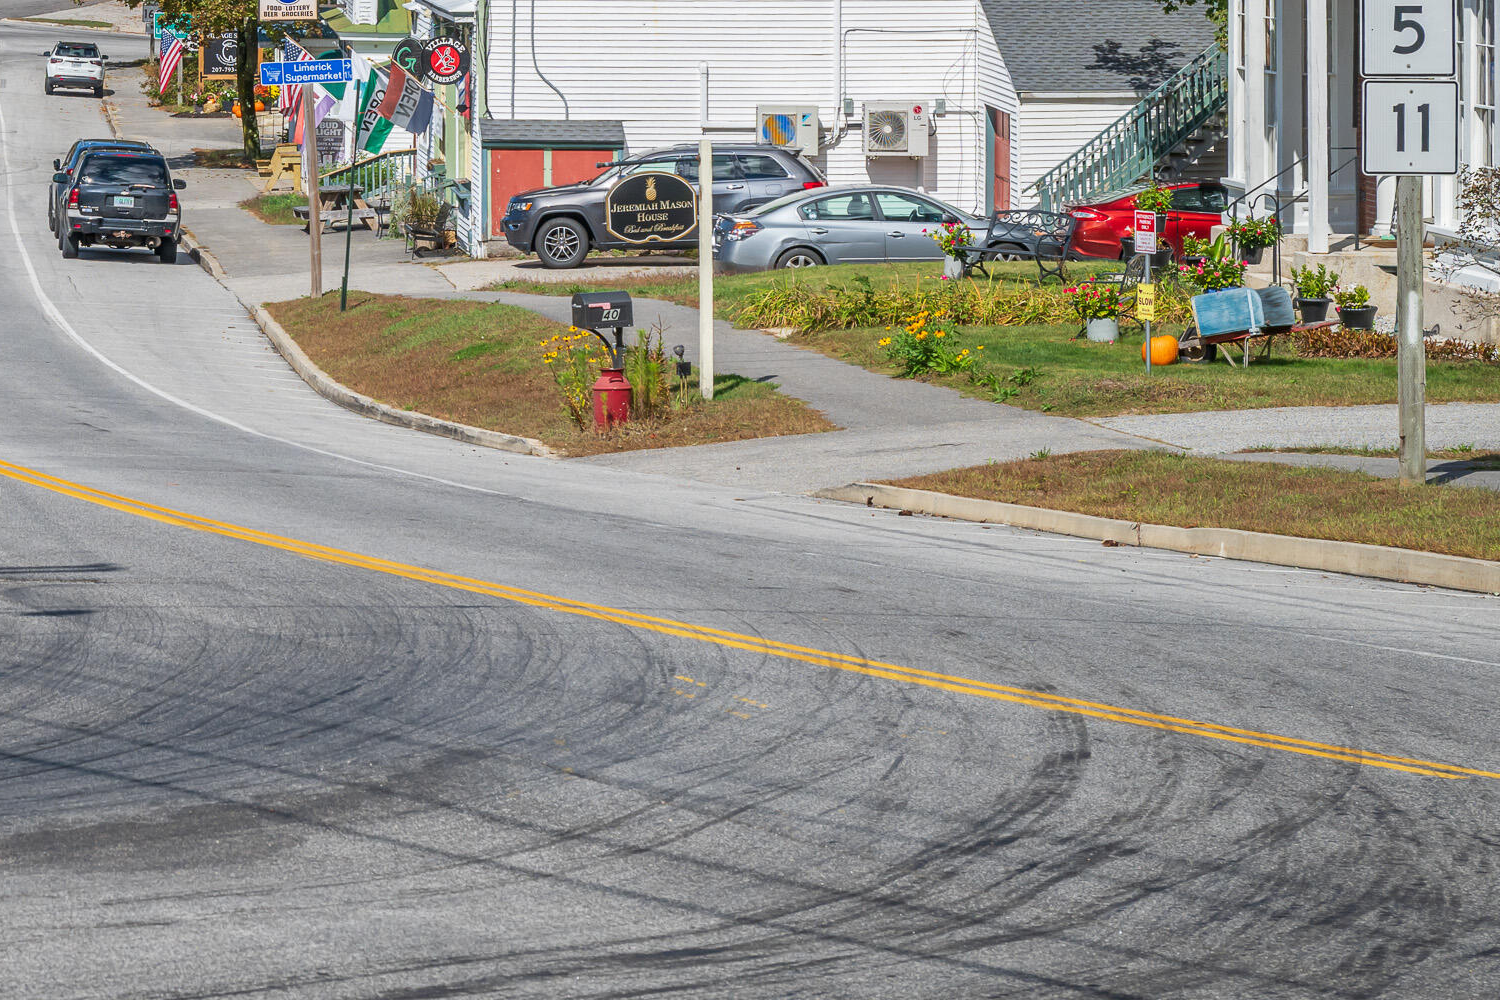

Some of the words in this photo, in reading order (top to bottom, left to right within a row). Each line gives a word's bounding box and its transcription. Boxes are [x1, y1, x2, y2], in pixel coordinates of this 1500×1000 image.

[144, 8, 161, 19] 16
[1393, 5, 1426, 55] 5
[425, 37, 466, 53] VILLAGE
[293, 62, 333, 72] Limerick
[285, 71, 343, 83] Supermarket
[427, 70, 463, 83] BARBERSHOP
[319, 121, 339, 129] BUD
[1392, 103, 1430, 152] 11
[315, 128, 343, 136] LIGHT
[610, 202, 658, 214] JEREMIAH
[659, 199, 693, 211] MASON
[636, 212, 669, 223] HOUSE
[624, 224, 640, 234] Bed
[653, 222, 685, 234] Breakfast
[1138, 296, 1154, 306] SLOW
[603, 309, 619, 320] 40
